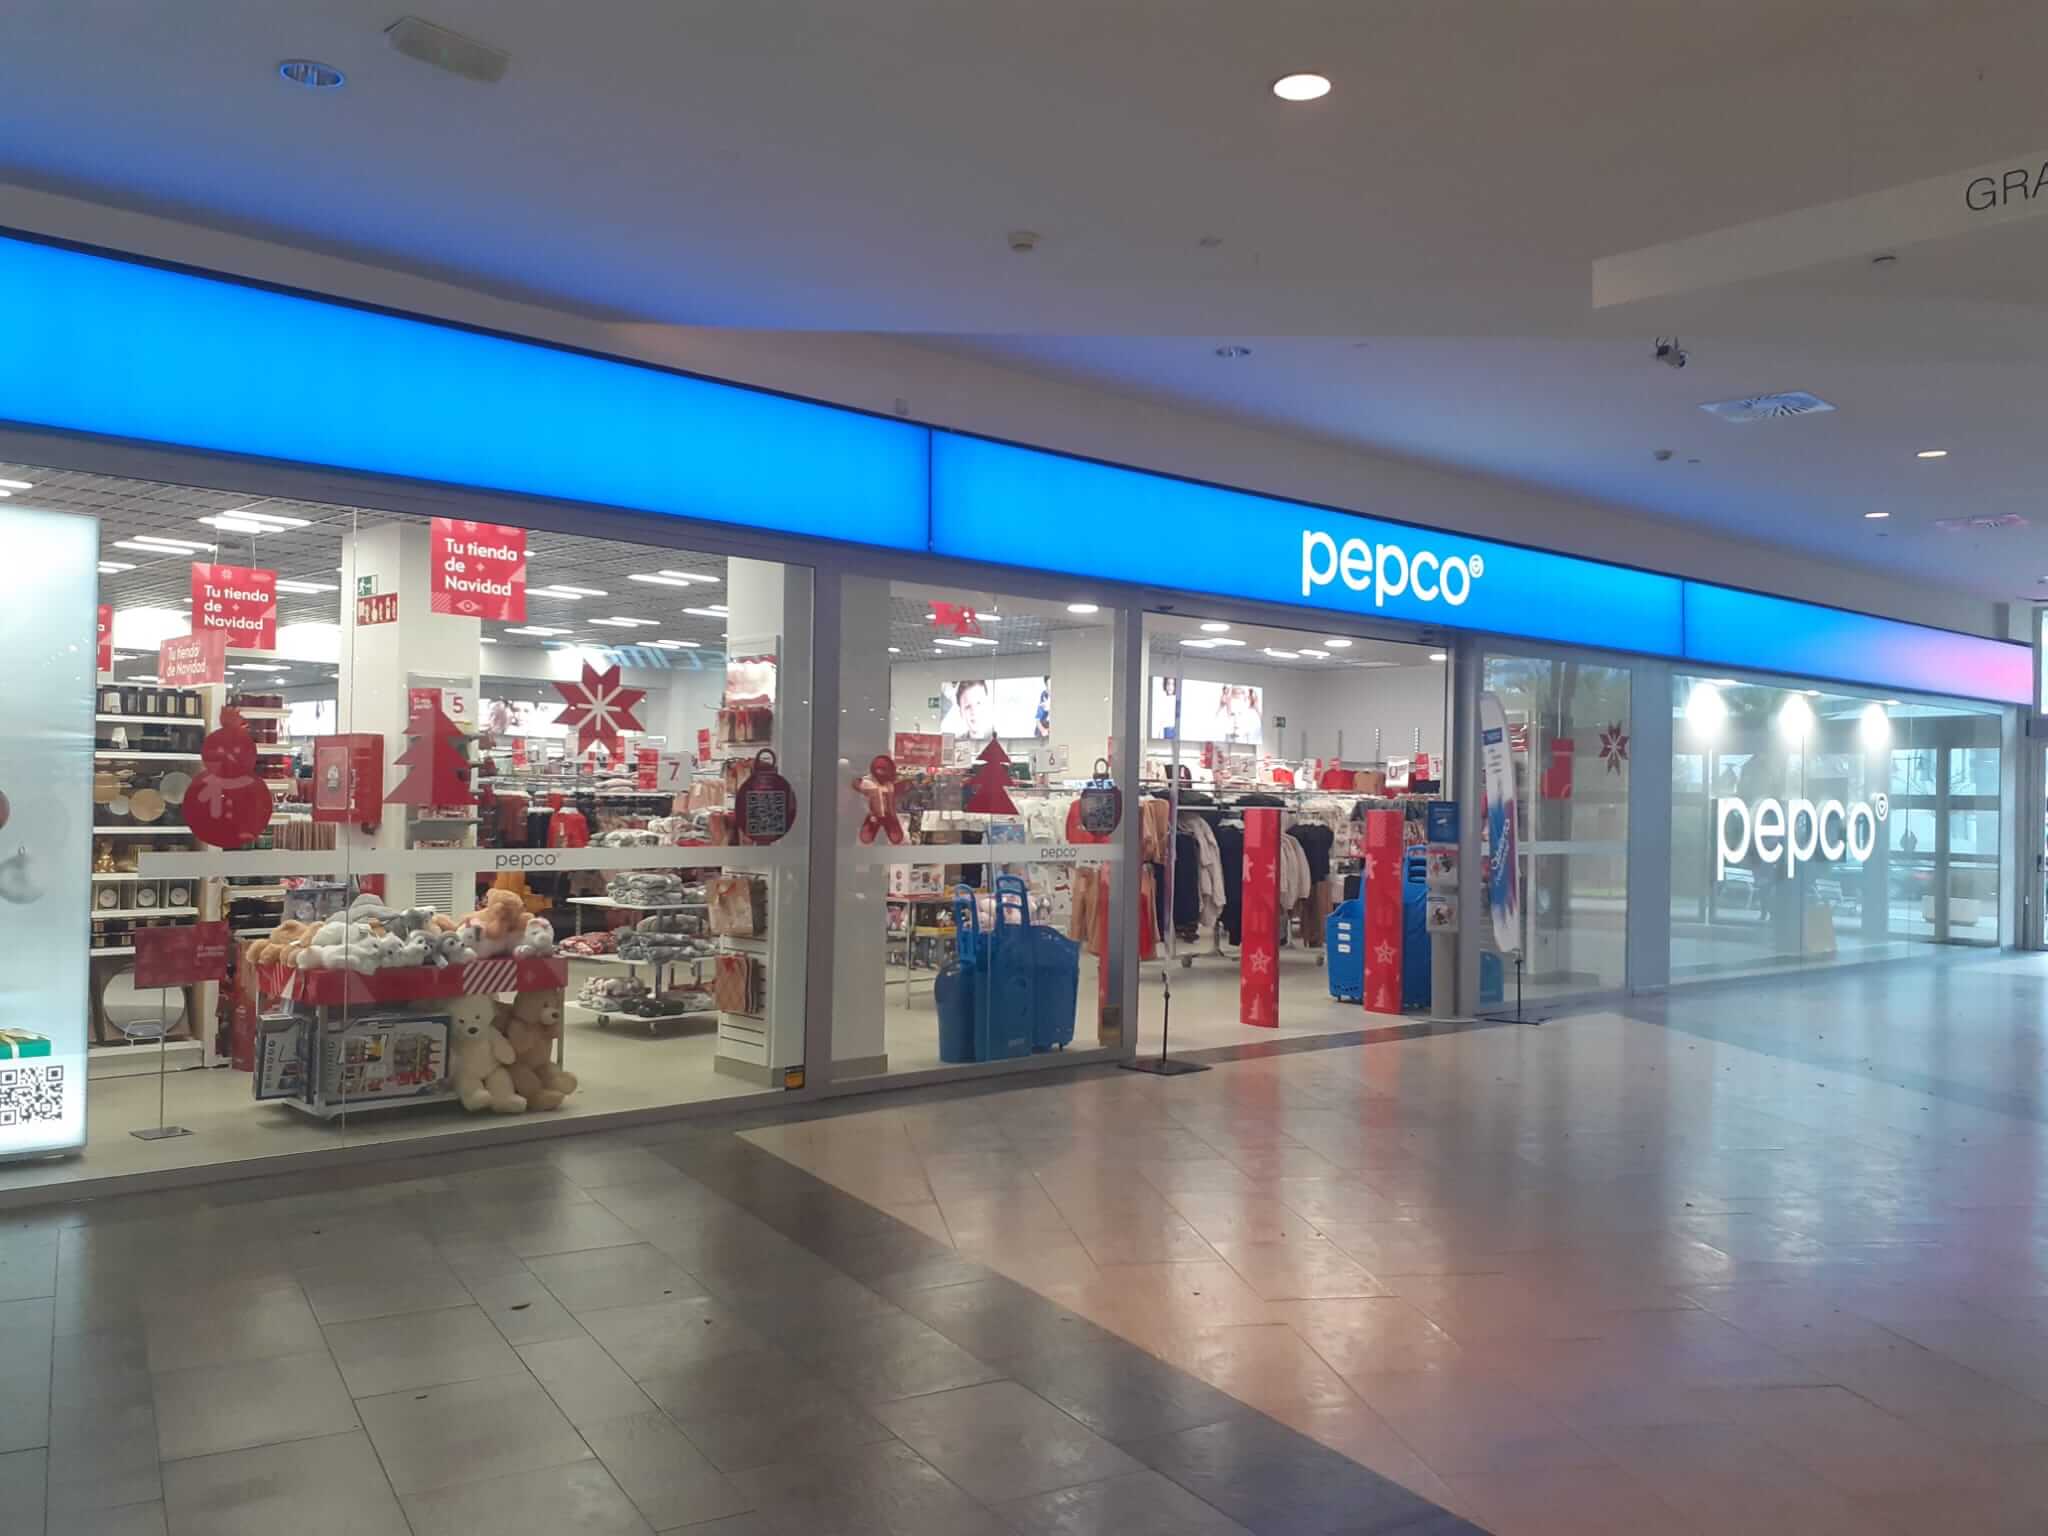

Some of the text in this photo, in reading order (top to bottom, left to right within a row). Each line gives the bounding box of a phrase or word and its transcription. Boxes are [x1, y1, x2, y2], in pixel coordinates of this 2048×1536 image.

[444, 537, 518, 561] Tu tienda
[444, 556, 465, 573] de
[1302, 529, 1471, 607] pepco
[203, 583, 269, 603] Tu tienda
[444, 574, 512, 597] Navidad
[203, 599, 222, 613] de
[203, 613, 264, 631] Navidad
[453, 696, 464, 714] 5
[668, 761, 680, 782] 7
[1717, 796, 1875, 881] pepco
[495, 853, 557, 870] pepco
[1040, 847, 1077, 861] pepco
